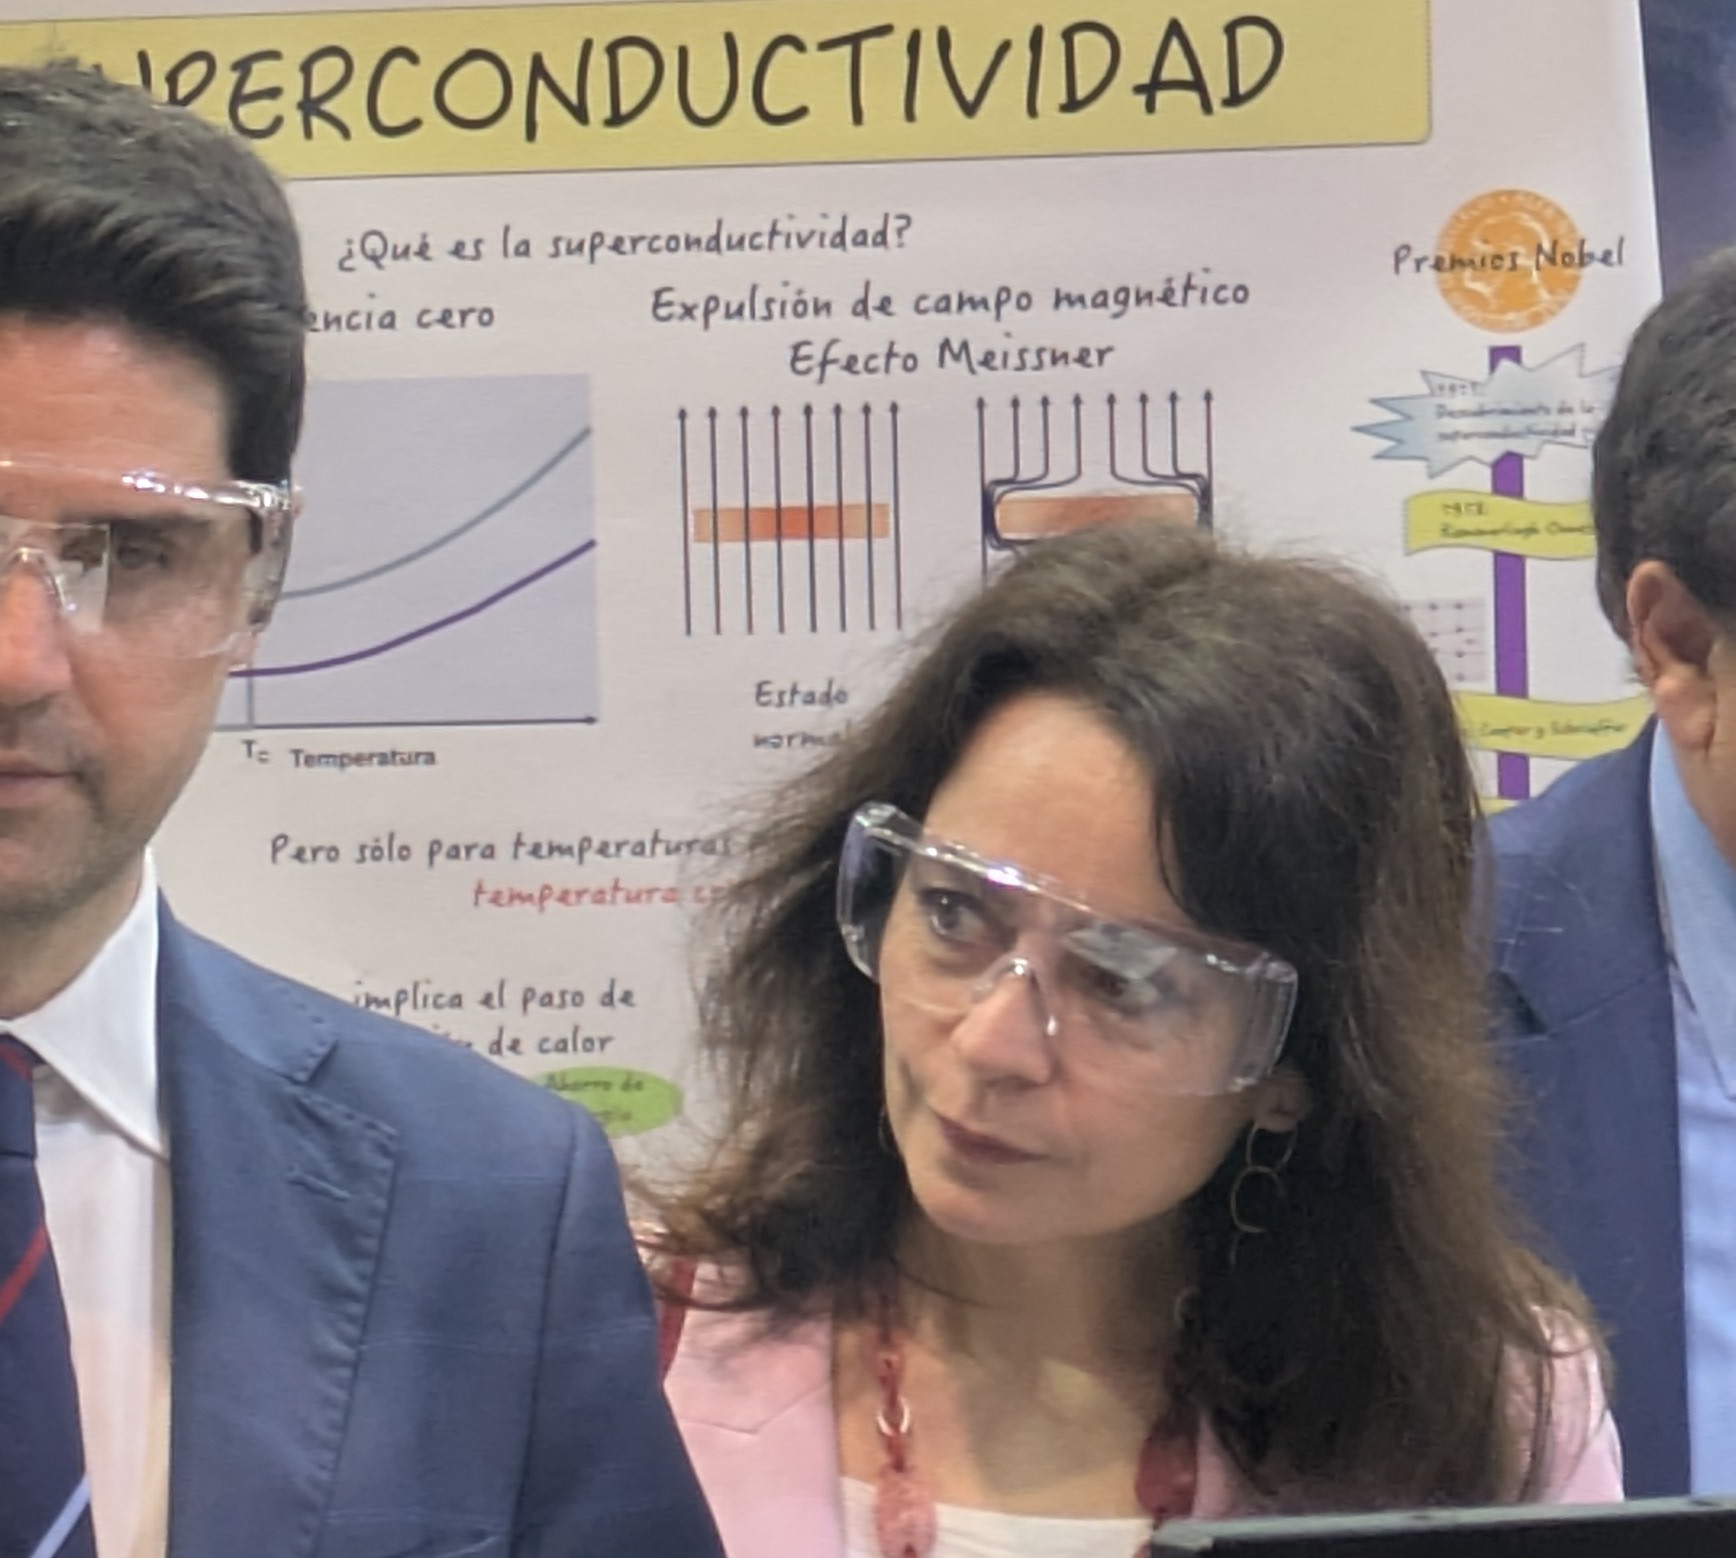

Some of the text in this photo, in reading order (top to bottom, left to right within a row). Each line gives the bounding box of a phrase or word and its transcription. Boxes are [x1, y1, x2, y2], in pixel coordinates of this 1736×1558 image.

[92, 15, 1285, 143] PERCONDUCTIVIDAD
[338, 213, 915, 272] ¿Qué es la superconductividad?
[1392, 235, 1625, 276] Premios Nobel
[416, 305, 495, 330] cero
[651, 268, 1251, 331] Expulsión de campo magnético
[789, 331, 1115, 386] Efecto Meissner
[754, 677, 849, 709] Estado
[290, 747, 437, 771] Temperatura
[270, 832, 341, 866] Pero
[355, 830, 413, 865] sólo
[428, 838, 497, 869] para
[474, 877, 680, 913] temperatura
[355, 978, 638, 1017] implica el paso de
[487, 1025, 525, 1057] de
[537, 1024, 616, 1055] calor
